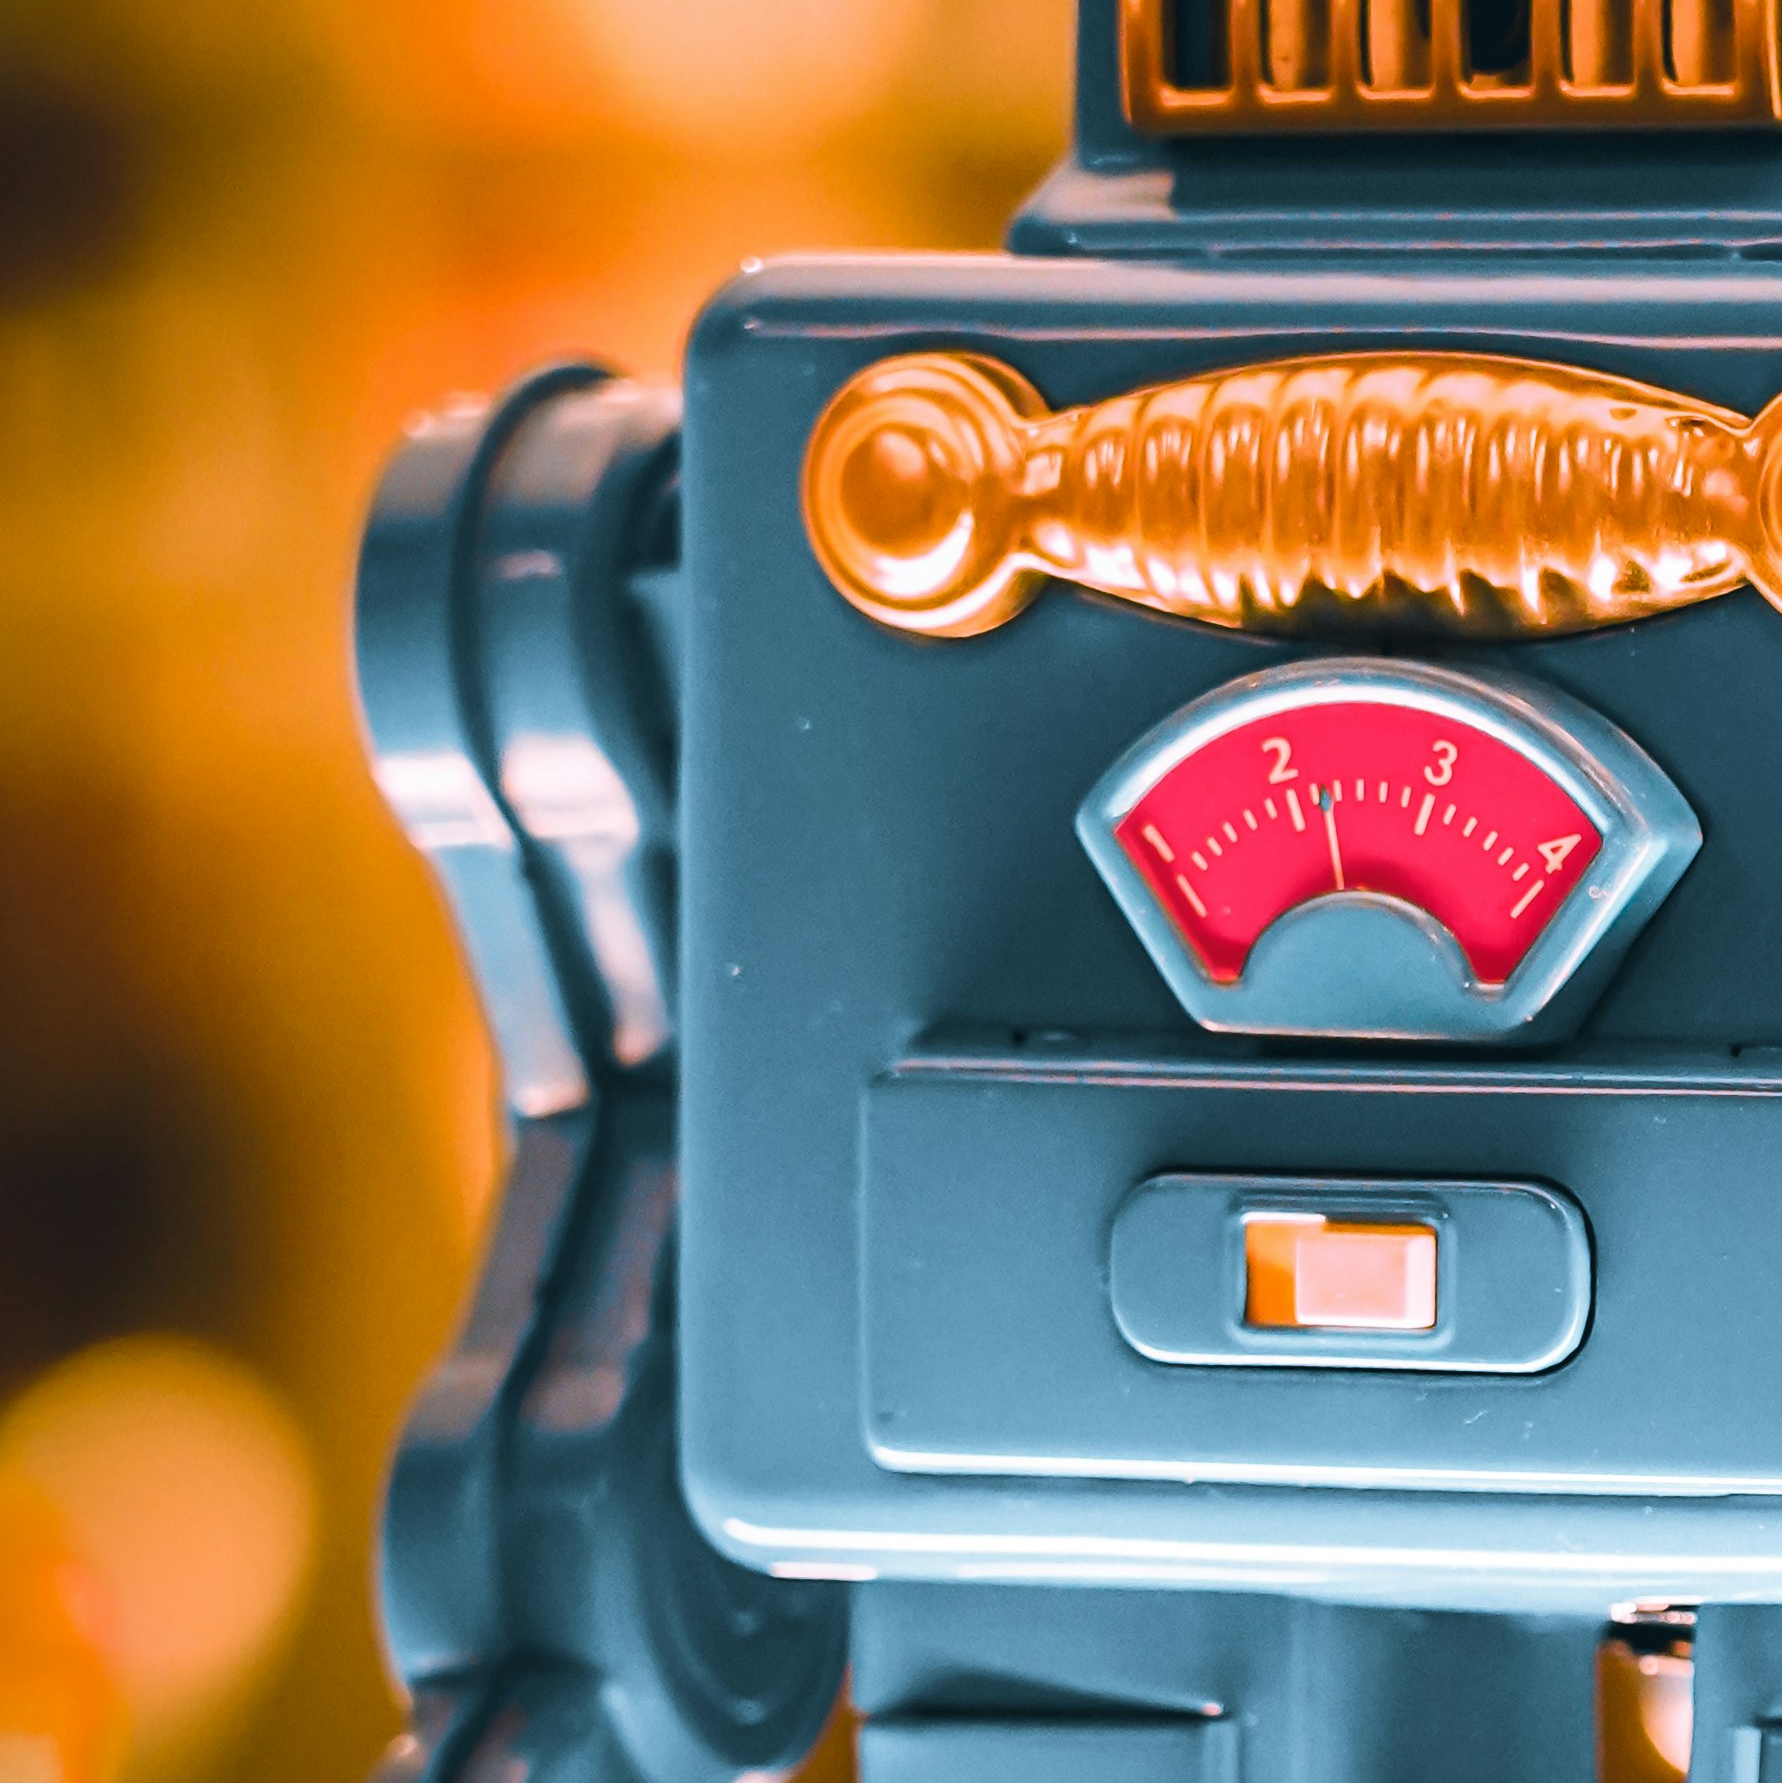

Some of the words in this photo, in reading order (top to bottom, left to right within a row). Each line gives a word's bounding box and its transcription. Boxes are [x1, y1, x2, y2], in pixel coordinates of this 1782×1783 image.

[1142, 824, 1175, 863] 1
[1261, 736, 1299, 785] 2
[1423, 739, 1458, 787] 3
[1537, 833, 1582, 875] 4
